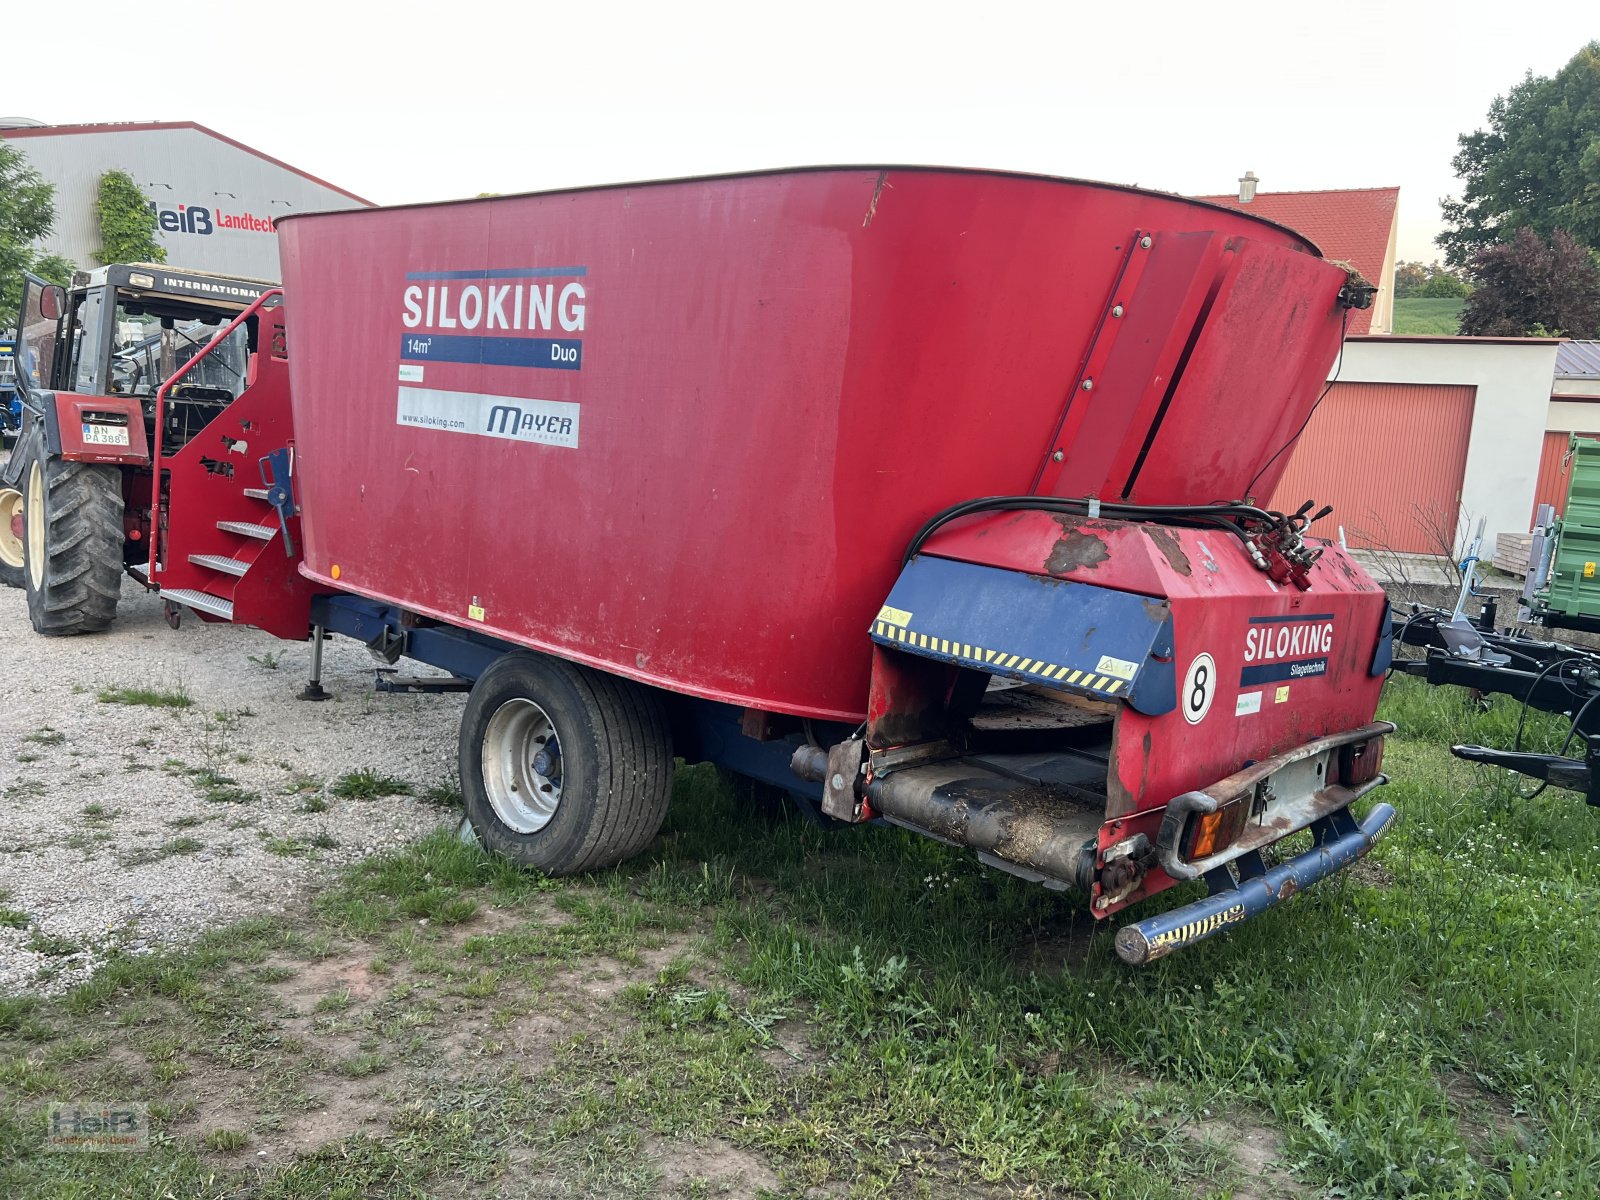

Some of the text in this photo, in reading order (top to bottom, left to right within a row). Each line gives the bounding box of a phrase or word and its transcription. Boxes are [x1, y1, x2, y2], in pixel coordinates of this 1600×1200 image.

[163, 278, 261, 298] INTERNATIONAL
[402, 282, 586, 332] SILOKING
[551, 344, 577, 362] Duo
[402, 405, 572, 435] www.siloking.com MAYER
[85, 434, 99, 442] PA
[101, 434, 121, 444] 388
[93, 426, 108, 435] AN
[1243, 623, 1333, 662] SILOKING
[1290, 661, 1325, 677] Silagetechnik
[1190, 664, 1208, 712] 8
